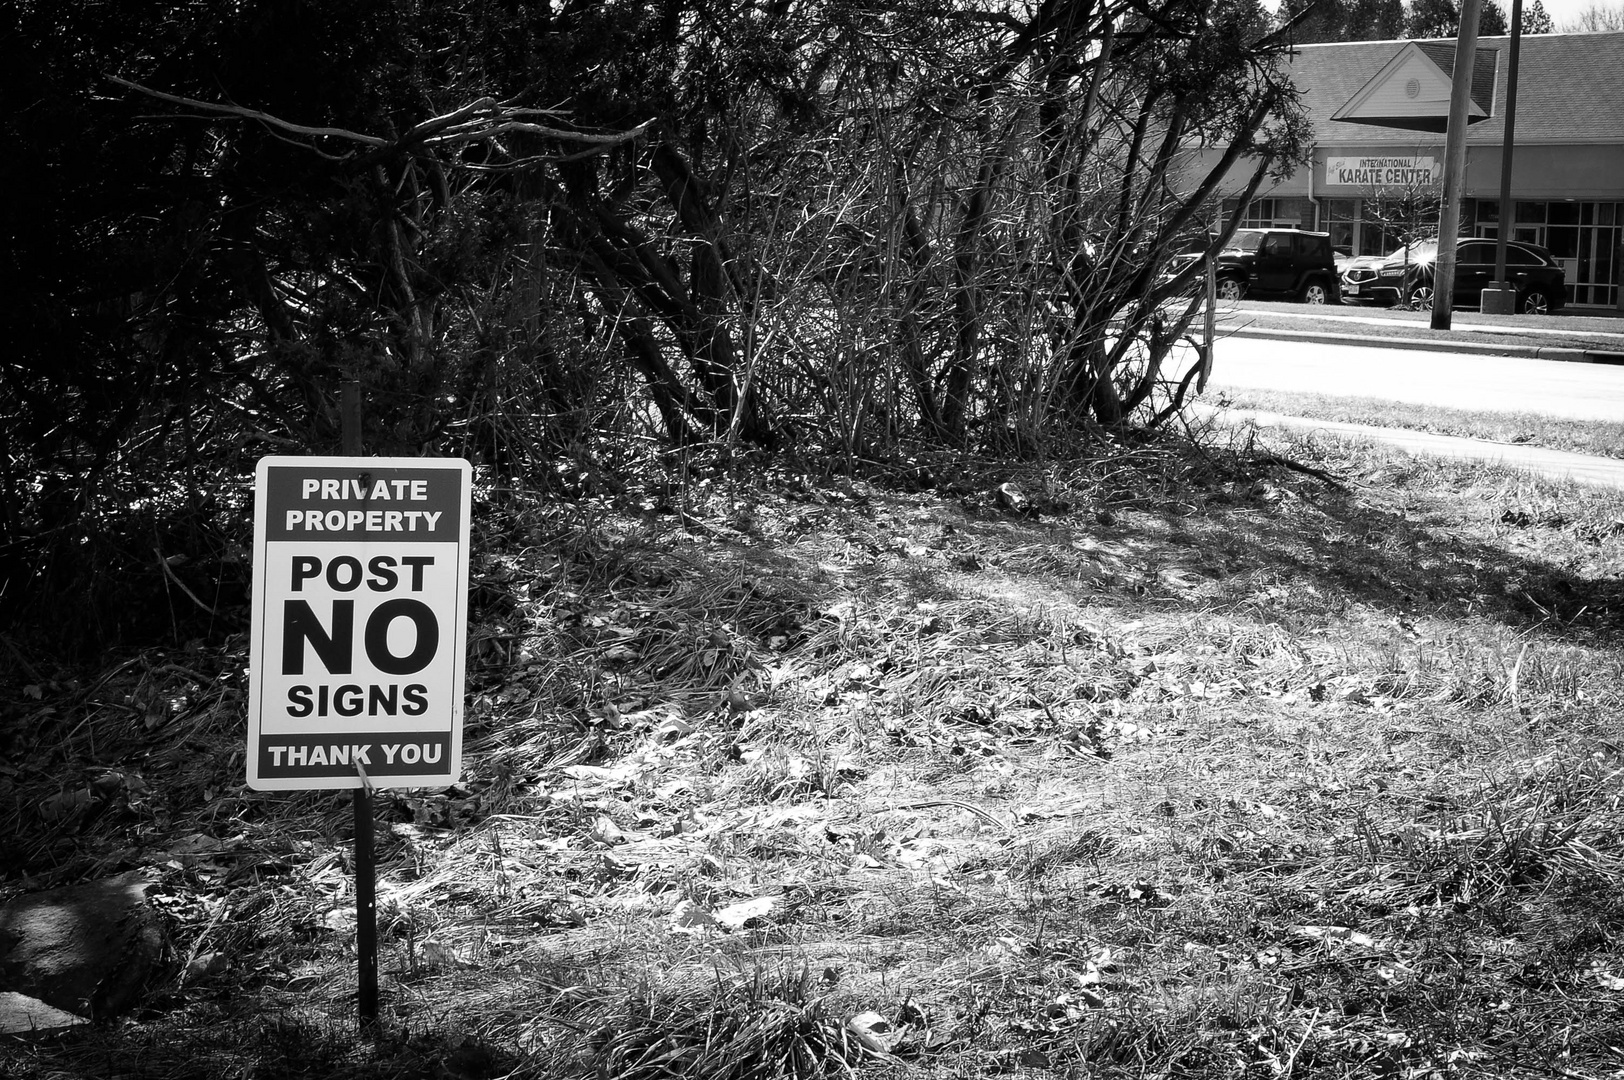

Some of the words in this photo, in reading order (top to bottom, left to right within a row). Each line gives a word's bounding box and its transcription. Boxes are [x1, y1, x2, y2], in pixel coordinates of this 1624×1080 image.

[1360, 159, 1411, 168] INTERNATIONAL
[1339, 169, 1382, 183] KARATE
[1385, 169, 1431, 183] CENTER
[302, 479, 428, 500] PRIVATE
[286, 510, 442, 532] PROPERTY
[291, 555, 435, 592] POST
[281, 598, 440, 676] NO
[286, 683, 429, 718] SIGNS
[268, 743, 373, 767] THANK
[381, 743, 442, 765] YOU
